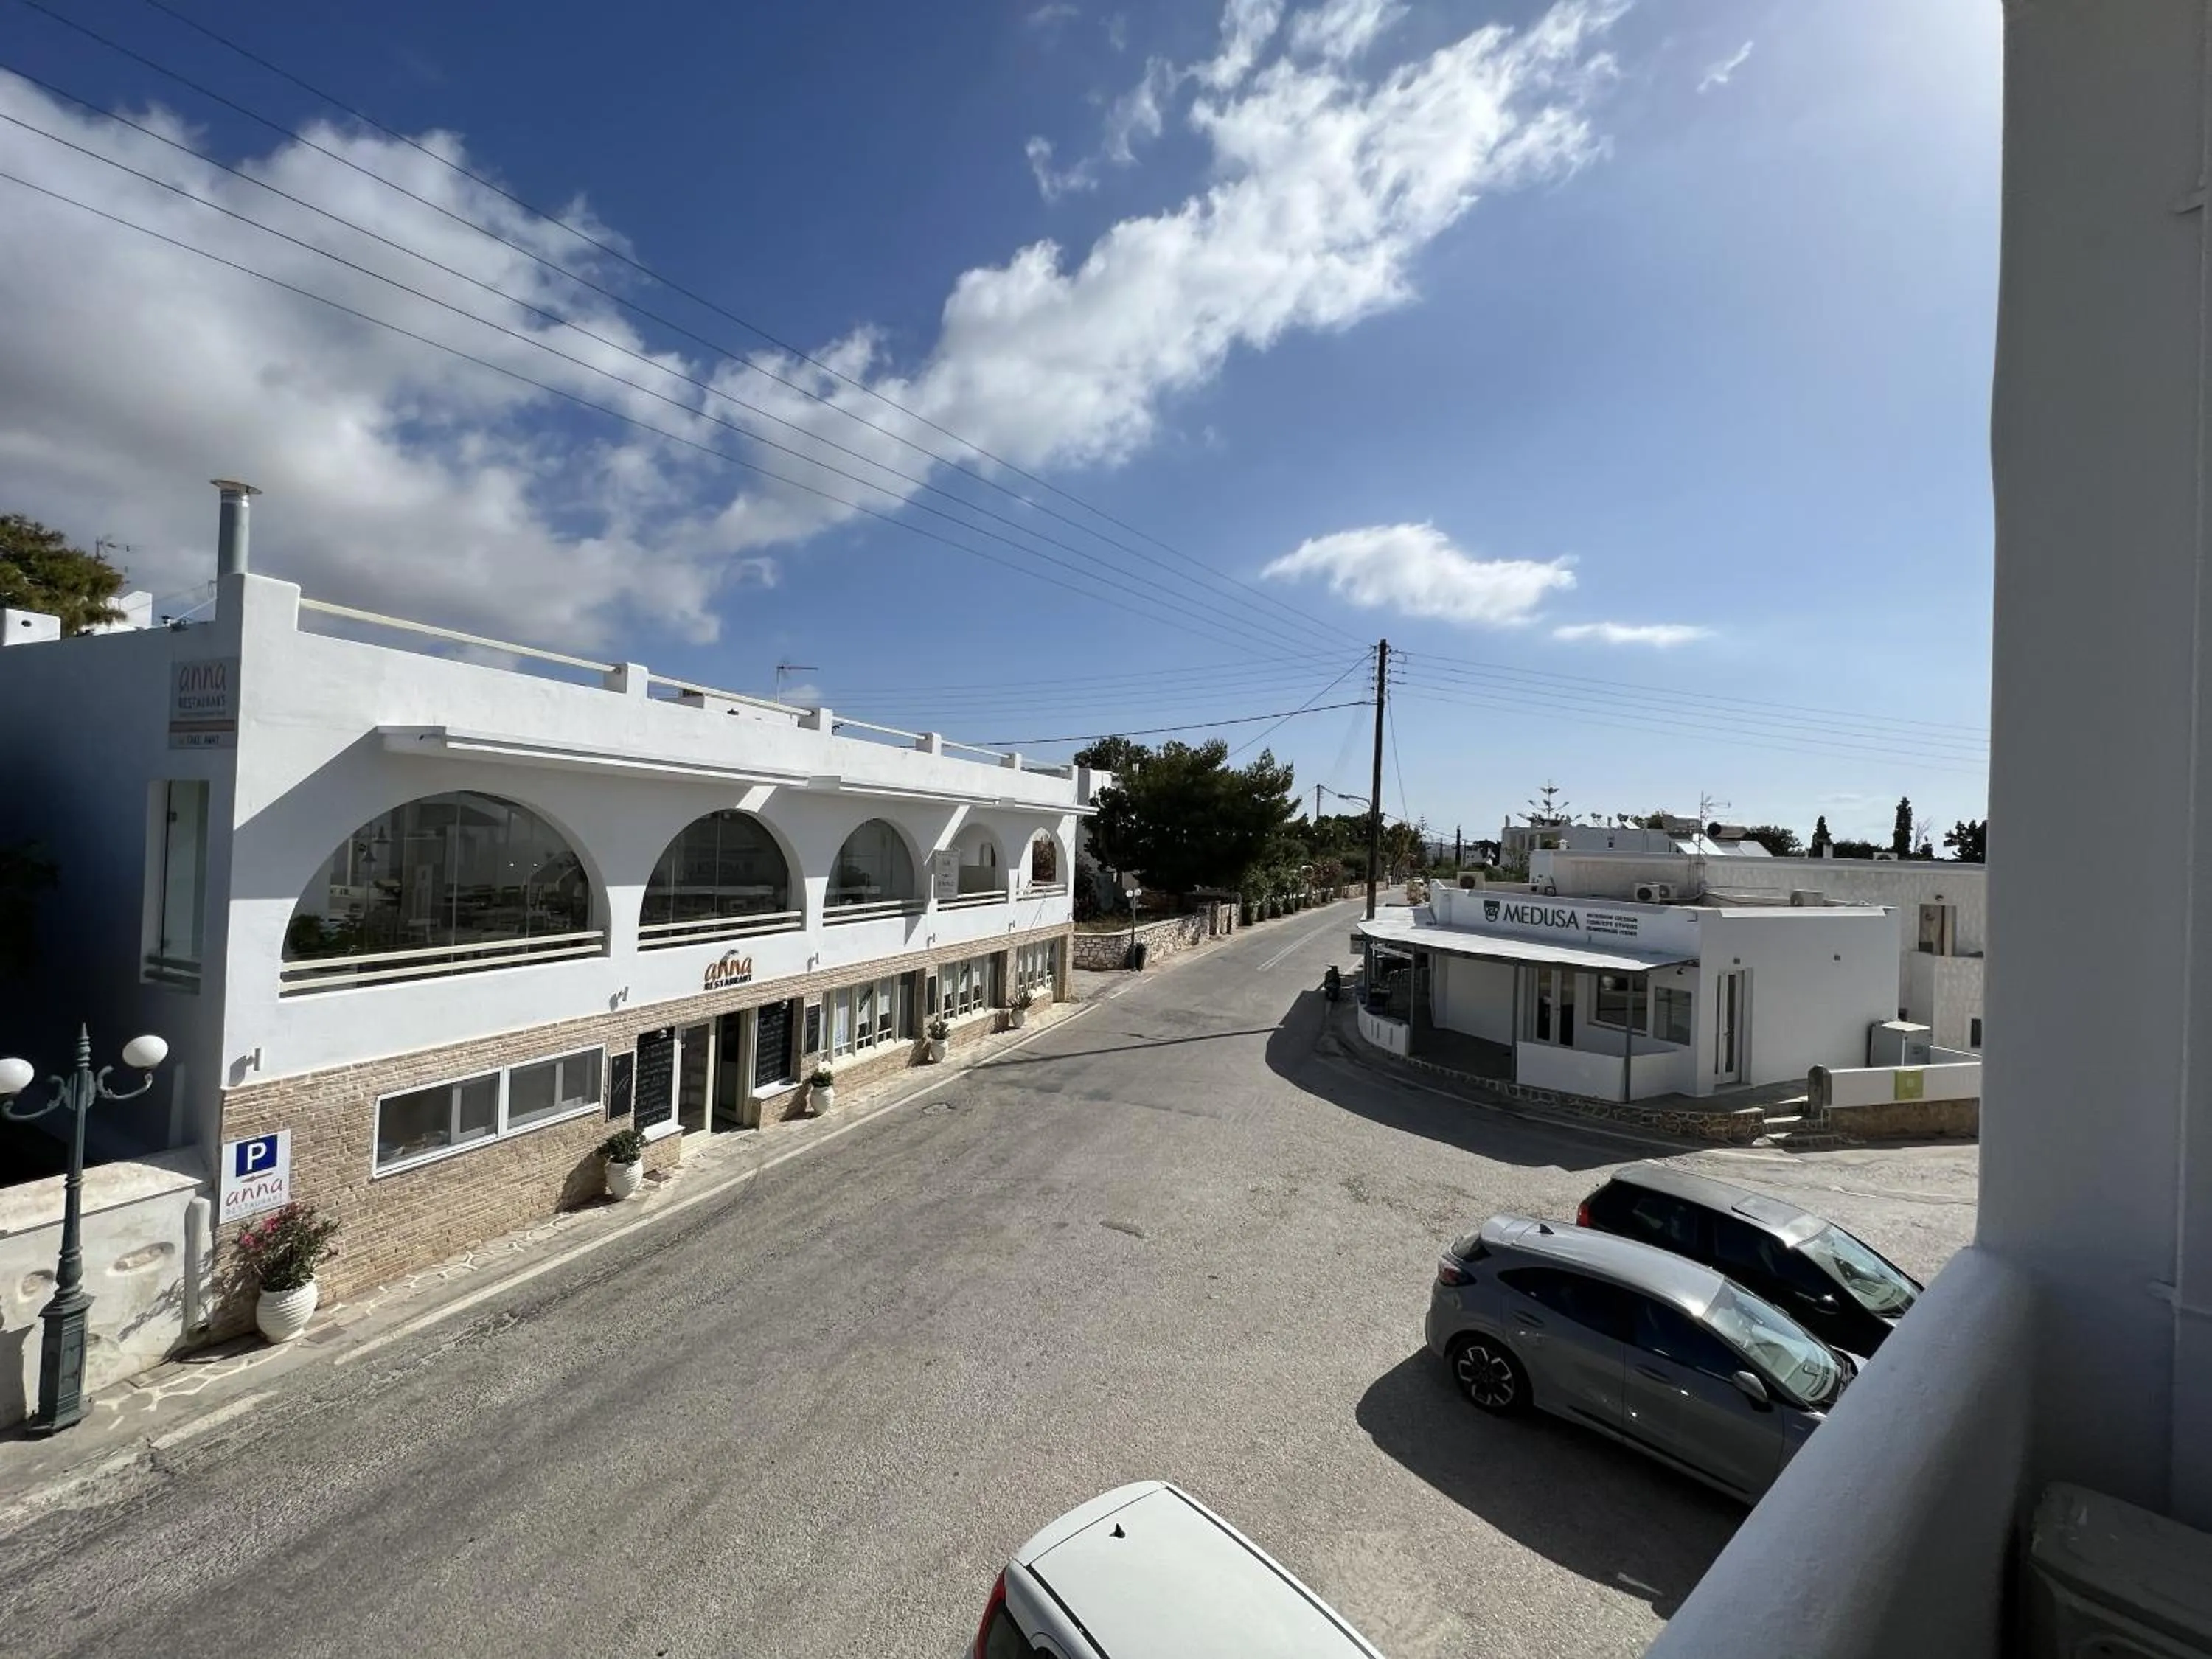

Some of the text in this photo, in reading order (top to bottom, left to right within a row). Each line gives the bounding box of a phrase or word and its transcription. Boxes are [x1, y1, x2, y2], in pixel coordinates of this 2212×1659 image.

[178, 663, 226, 692] anna
[1503, 904, 1579, 930] MEDUSA
[704, 957, 752, 983] anna
[247, 1142, 267, 1170] P
[226, 1178, 283, 1207] anna
